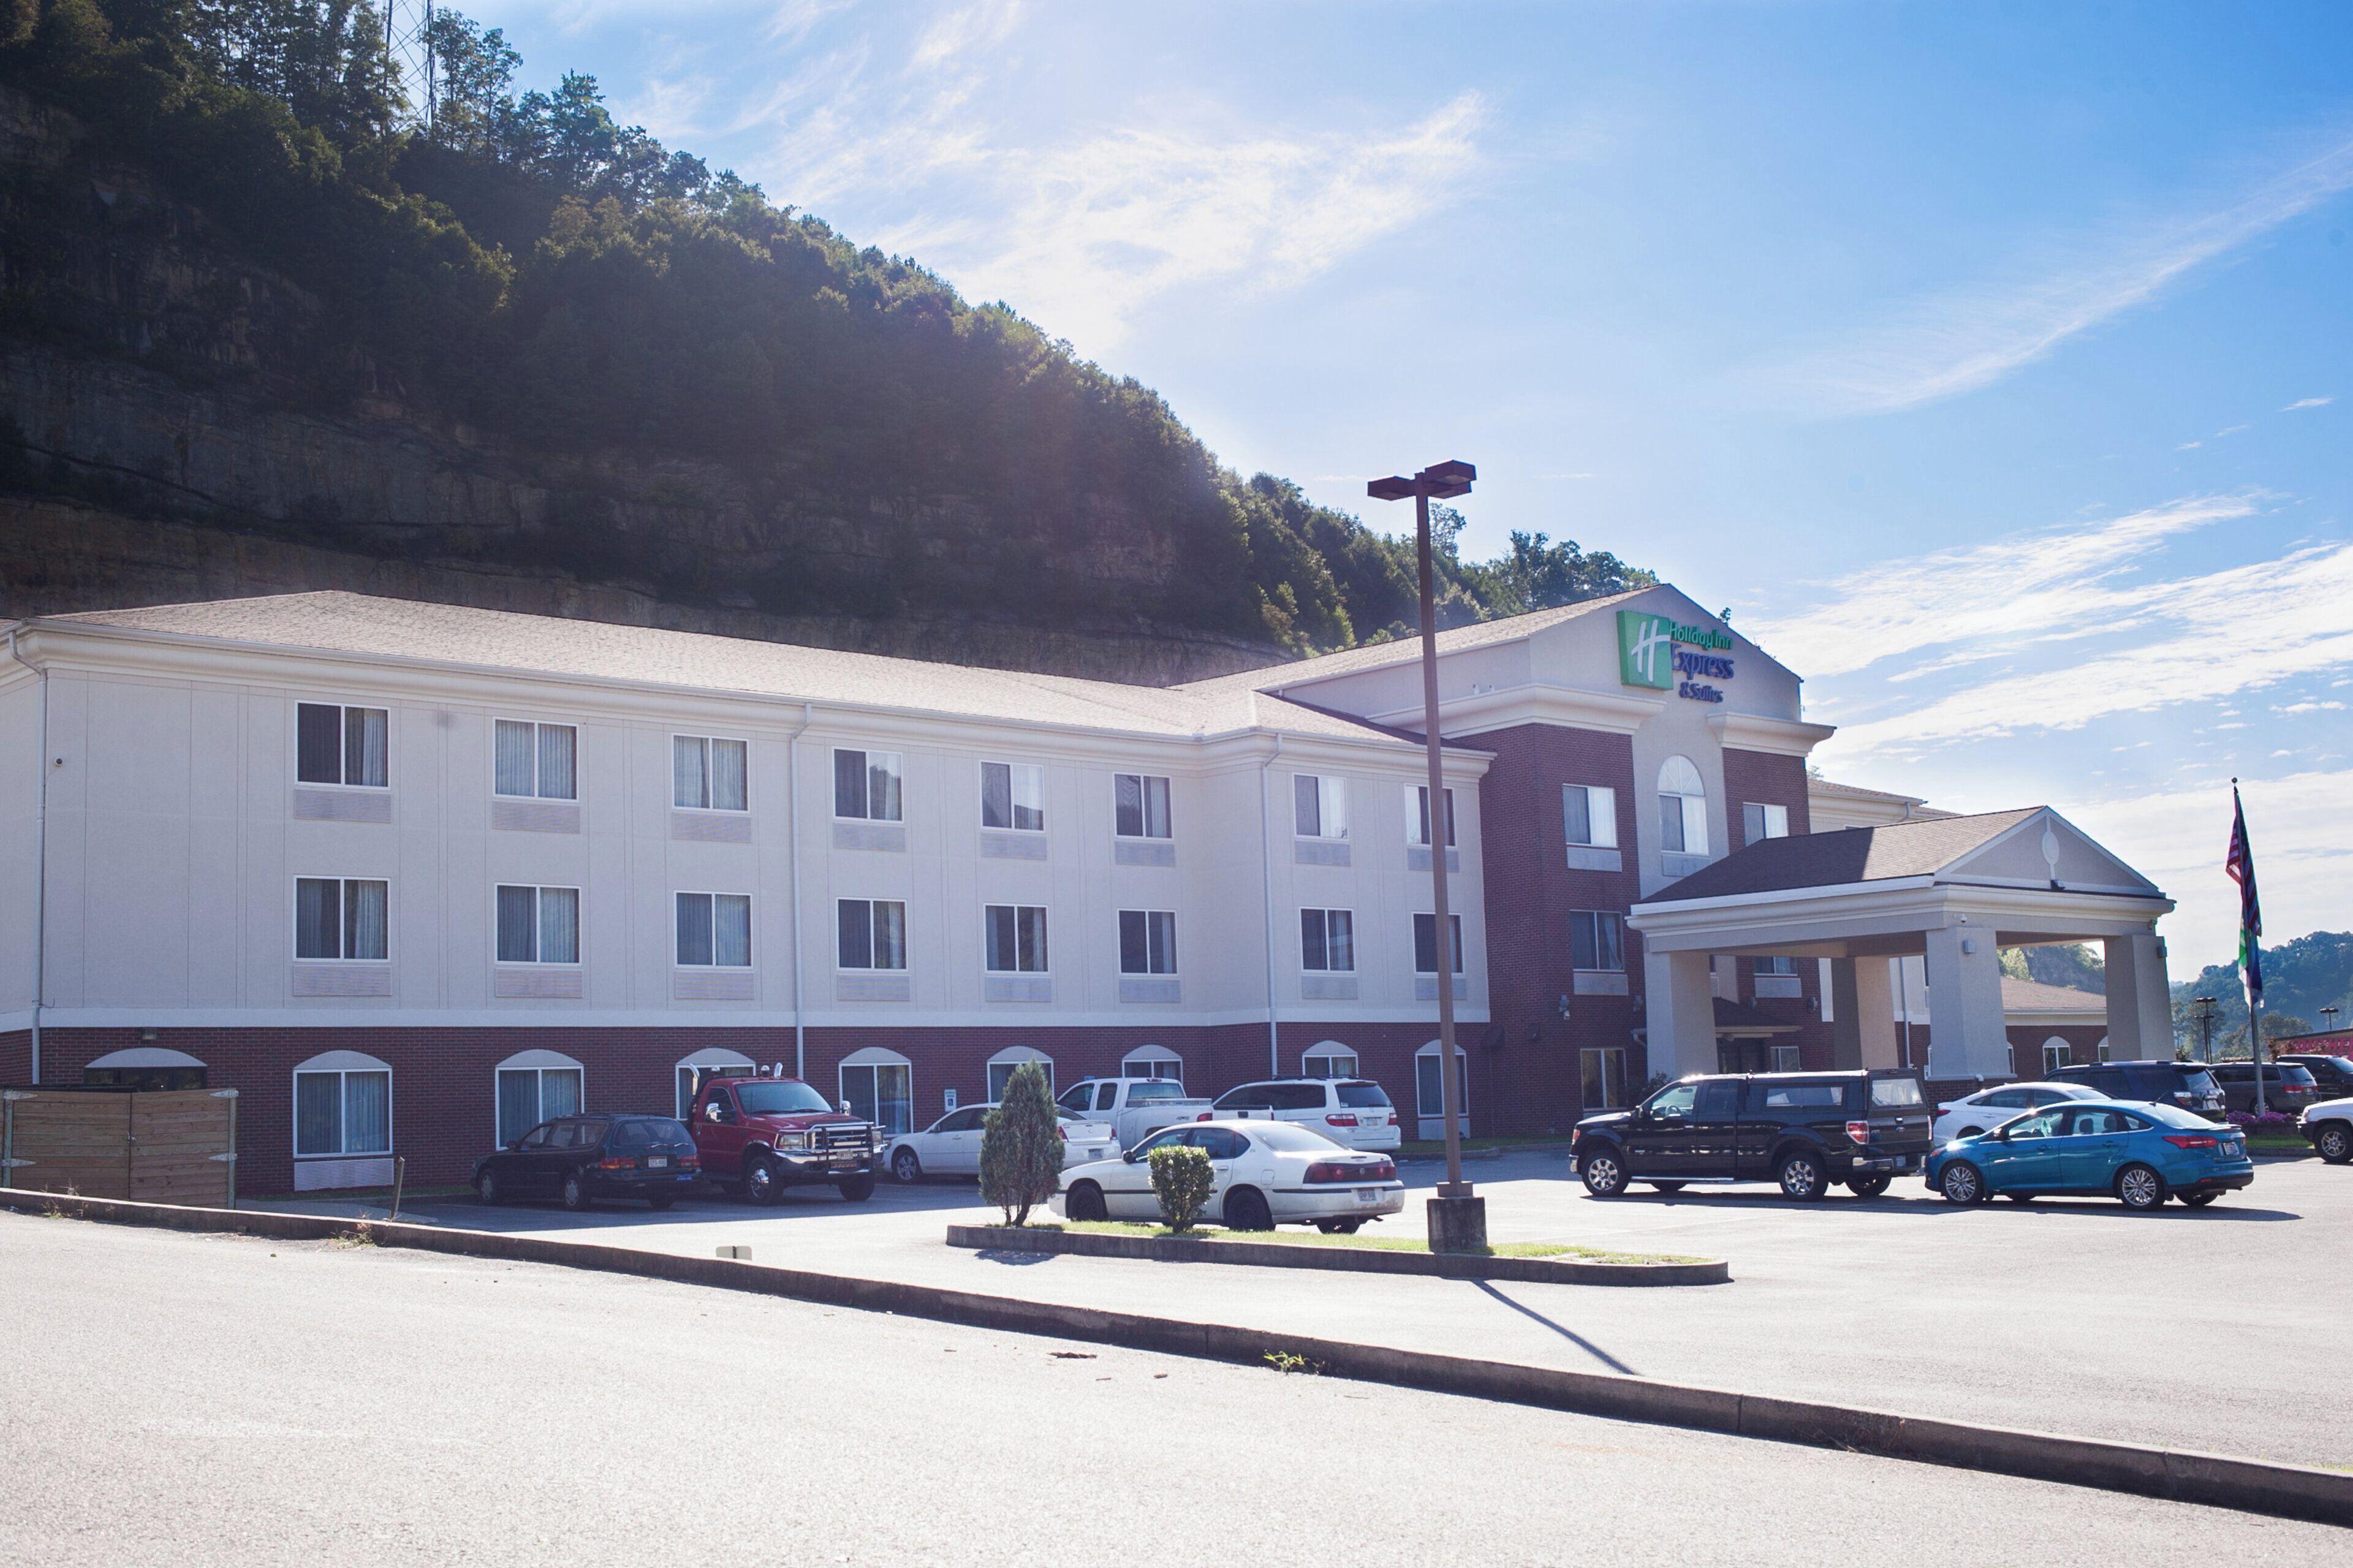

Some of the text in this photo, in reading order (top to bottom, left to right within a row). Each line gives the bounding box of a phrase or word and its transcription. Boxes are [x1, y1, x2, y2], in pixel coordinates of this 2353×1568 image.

[1670, 621, 1733, 651] Holiday Inn
[1671, 643, 1735, 680] Express
[1689, 683, 1724, 703] Suites
